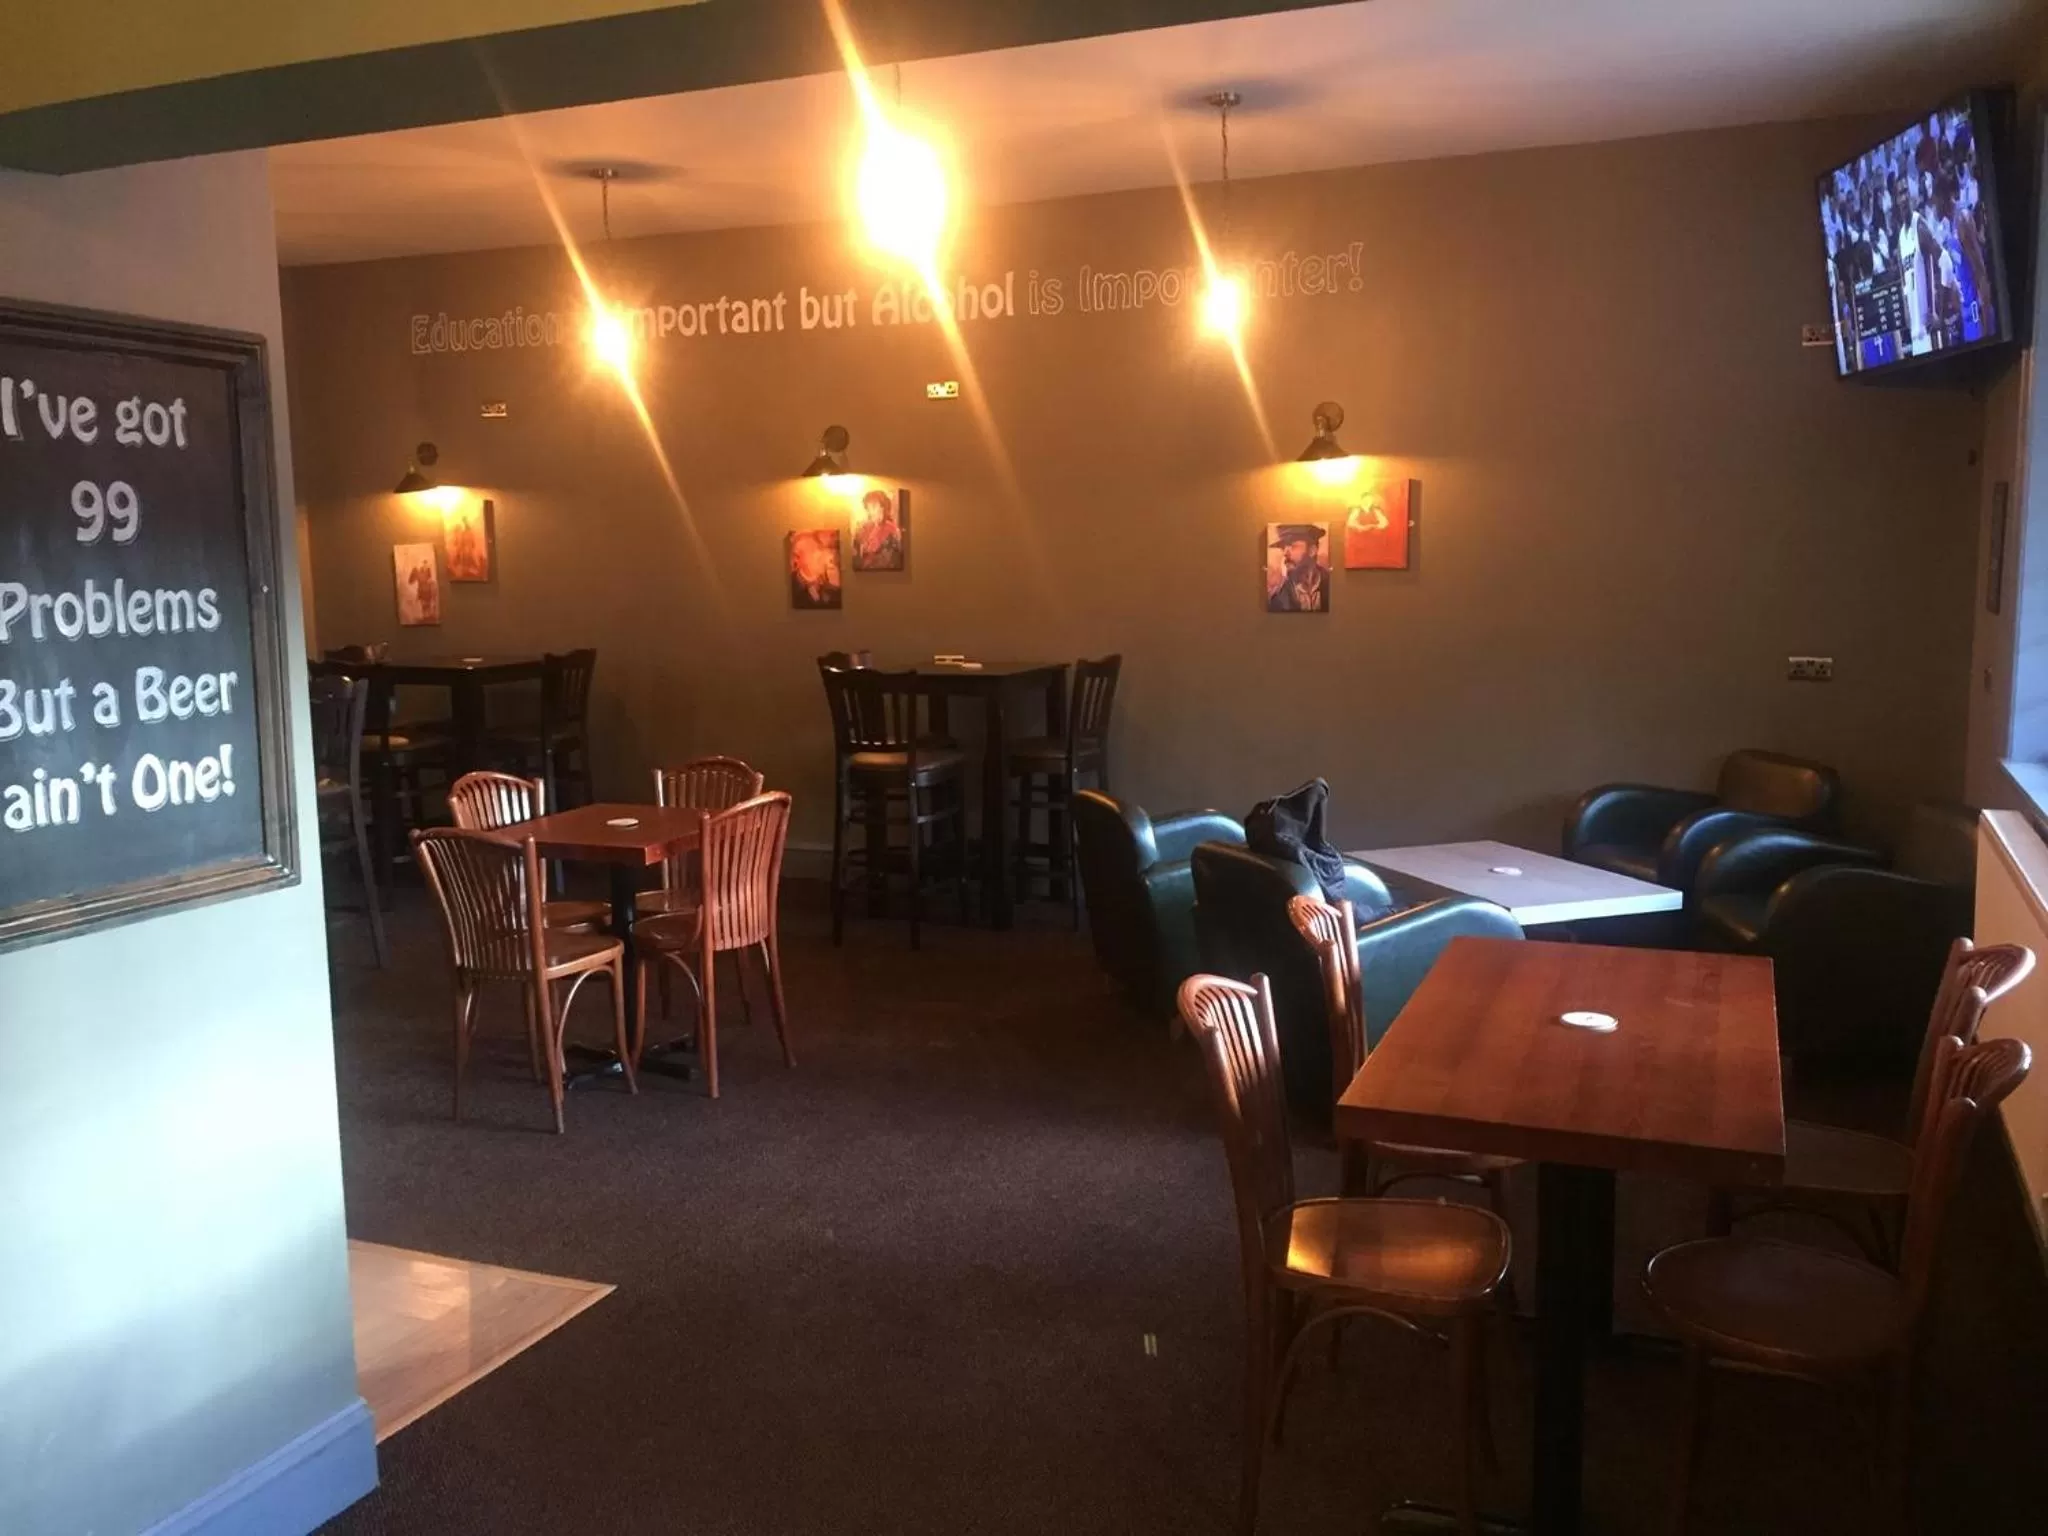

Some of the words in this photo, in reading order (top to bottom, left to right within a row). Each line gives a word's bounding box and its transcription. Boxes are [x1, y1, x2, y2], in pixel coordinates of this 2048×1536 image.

[411, 307, 562, 355] Education
[622, 291, 787, 341] mportant
[799, 286, 858, 330] but
[1028, 269, 1065, 315] is
[1078, 241, 1365, 313] Impornter!
[0, 376, 99, 445] I've
[115, 396, 188, 449] got
[71, 480, 142, 546] 99
[0, 578, 221, 643] Problems
[0, 677, 77, 740] But
[92, 682, 120, 727] a
[134, 665, 238, 724] Beer
[3, 760, 117, 831] ain't
[132, 744, 236, 813] One!
